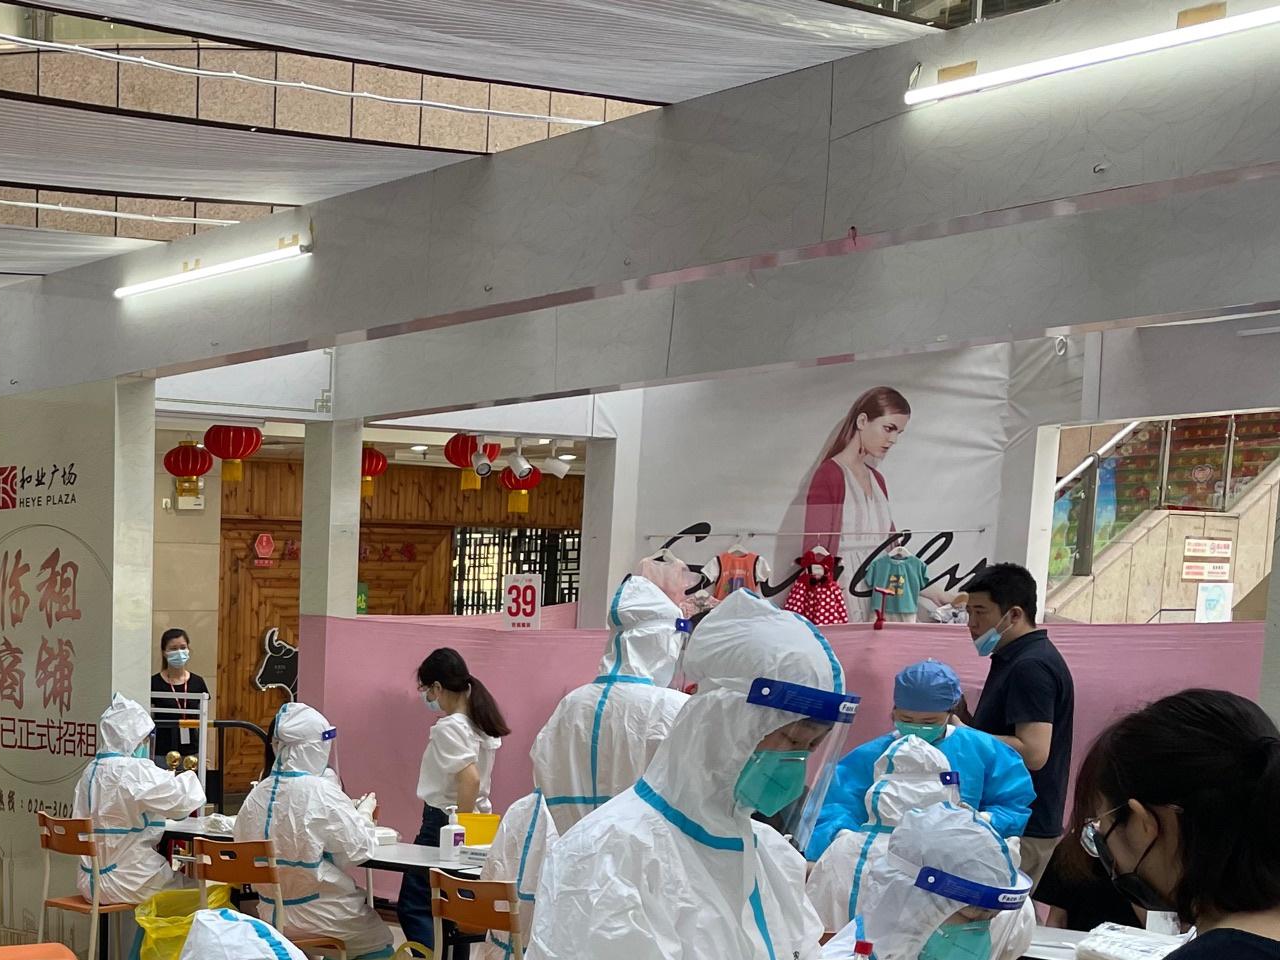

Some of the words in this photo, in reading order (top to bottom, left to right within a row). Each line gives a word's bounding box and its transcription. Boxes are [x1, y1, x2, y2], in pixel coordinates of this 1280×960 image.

[19, 462, 78, 490] 和业广场
[19, 496, 42, 508] HEYE
[46, 493, 77, 506] PLAZA
[507, 584, 536, 618] 39
